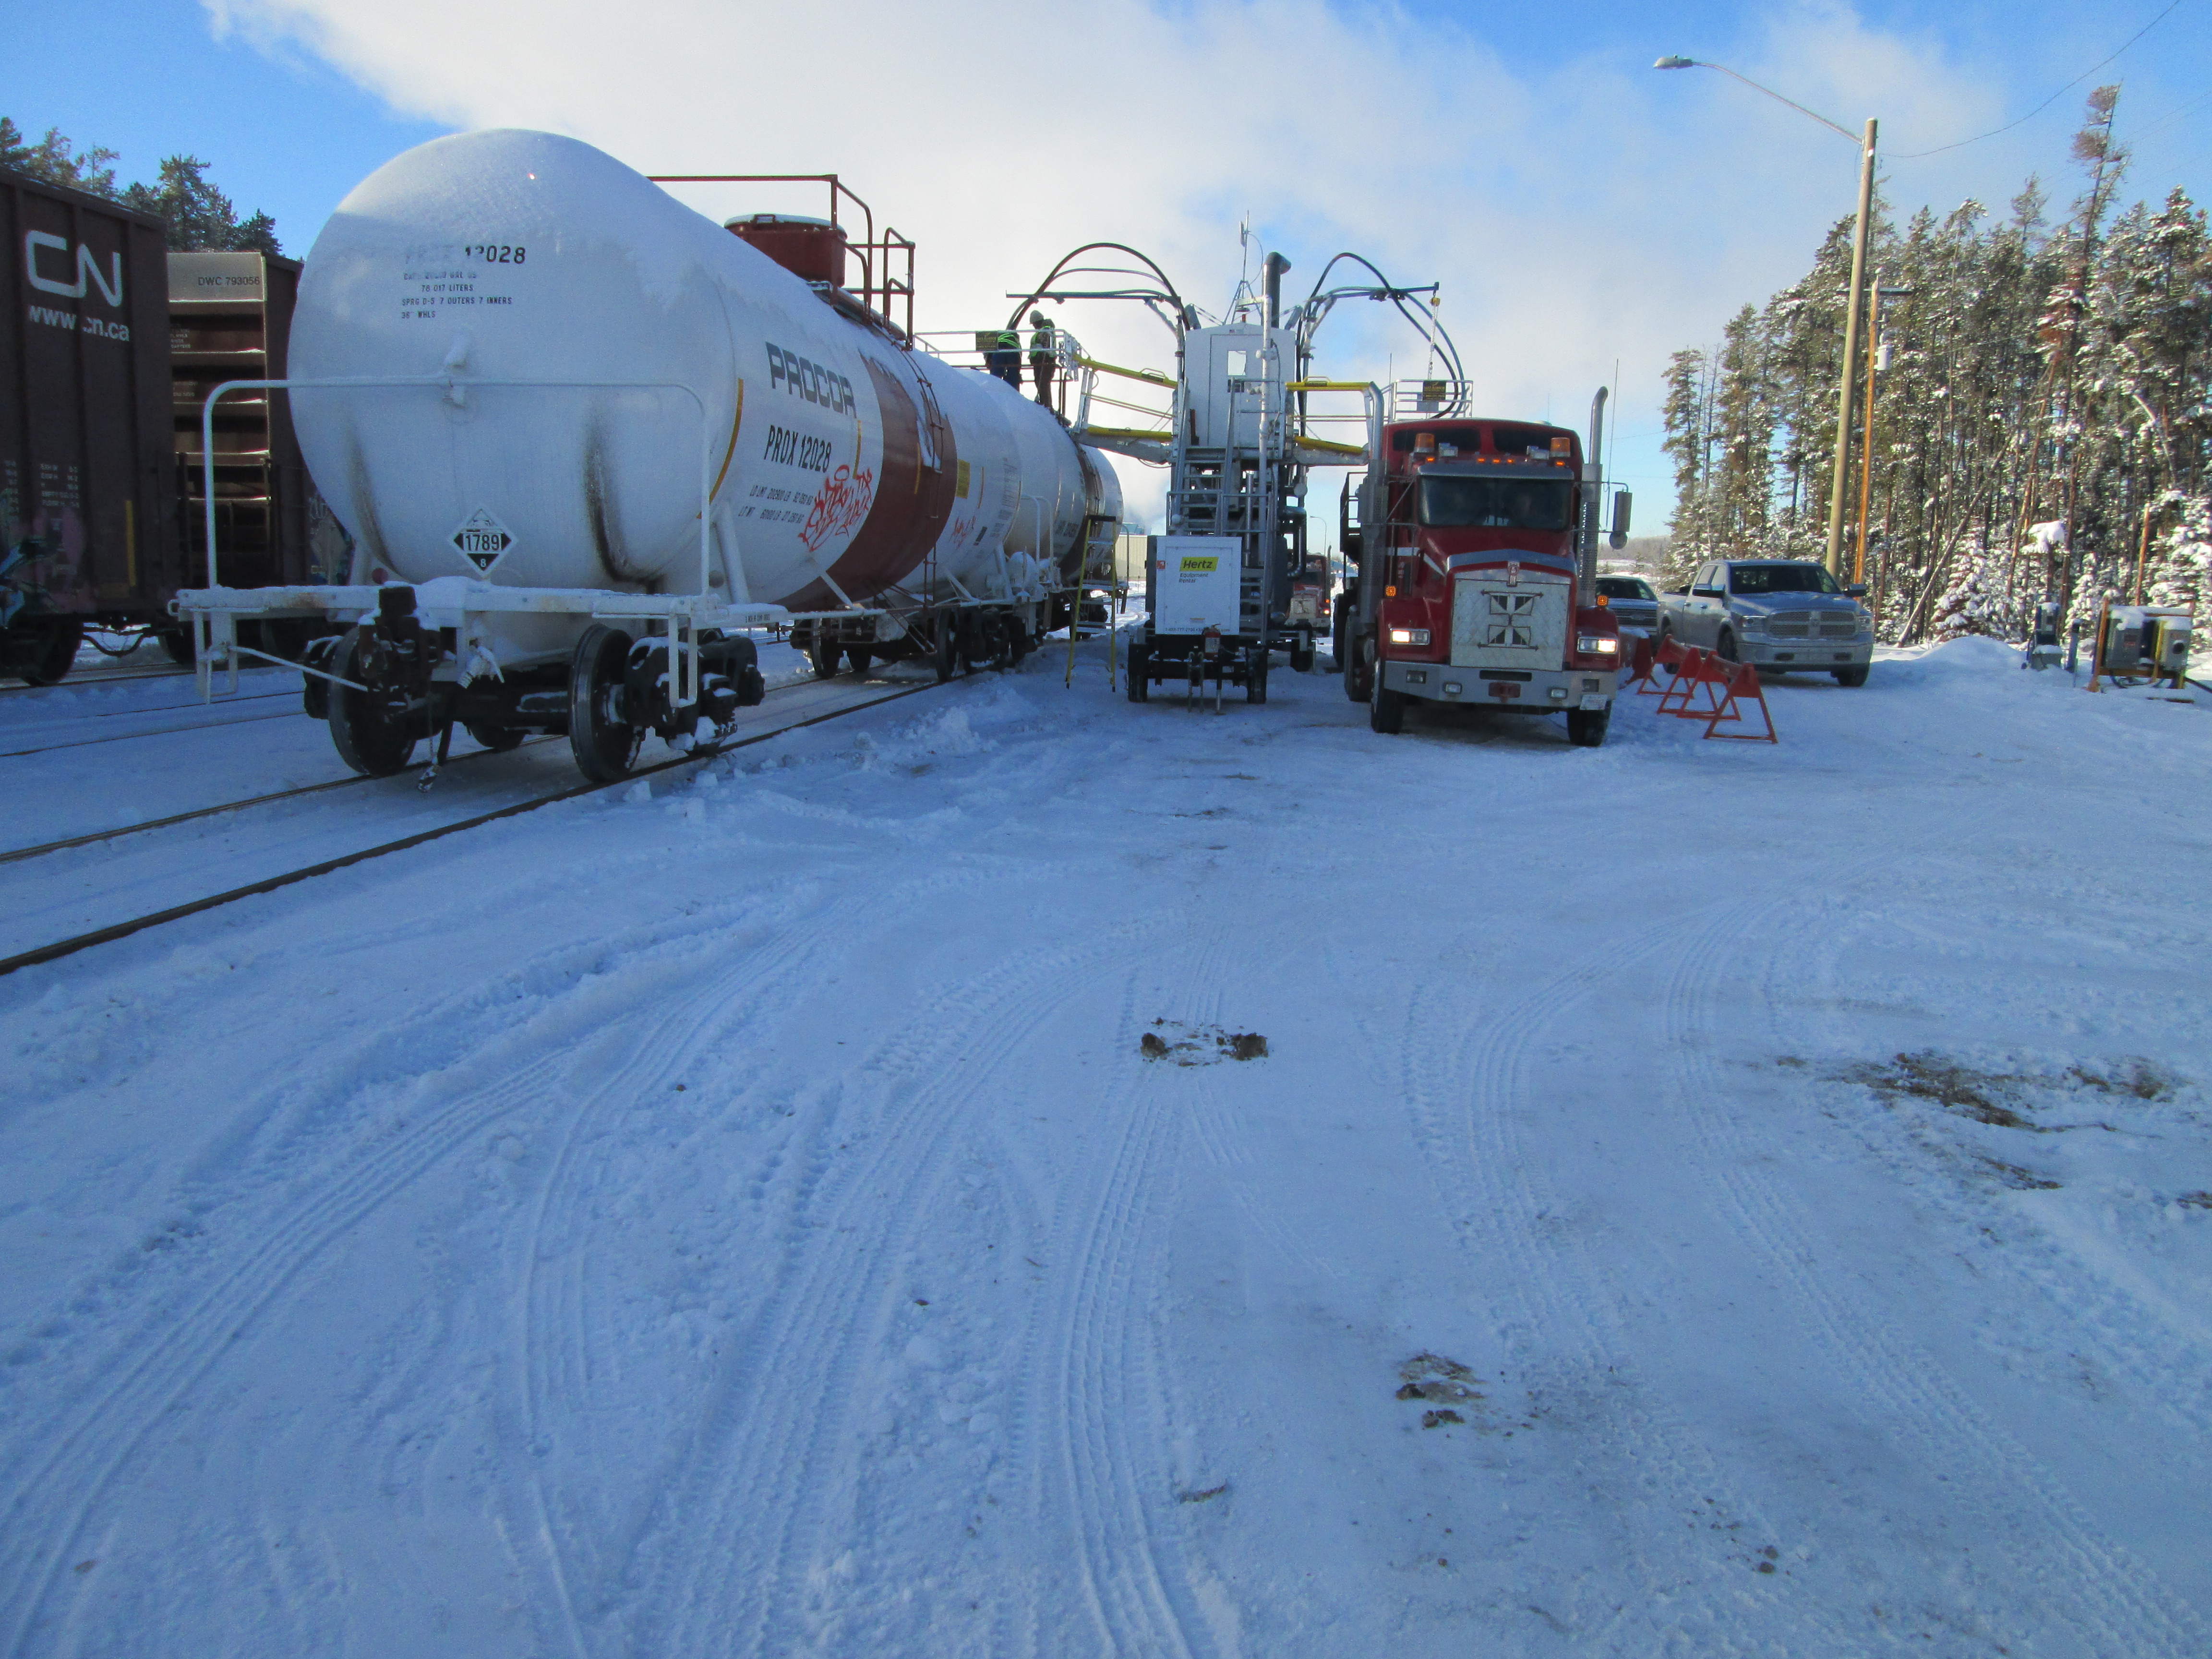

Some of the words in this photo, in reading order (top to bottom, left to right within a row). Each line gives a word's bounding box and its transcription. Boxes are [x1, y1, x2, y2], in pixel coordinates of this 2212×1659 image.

[25, 230, 123, 307] CN
[198, 276, 222, 286] DWC
[226, 276, 260, 286] 793056
[765, 341, 856, 419] PROCOR
[764, 425, 798, 465] PROX
[798, 434, 831, 473] 12028
[466, 534, 500, 551] 1789
[481, 558, 486, 567] 8
[1183, 560, 1213, 569] Hertz
